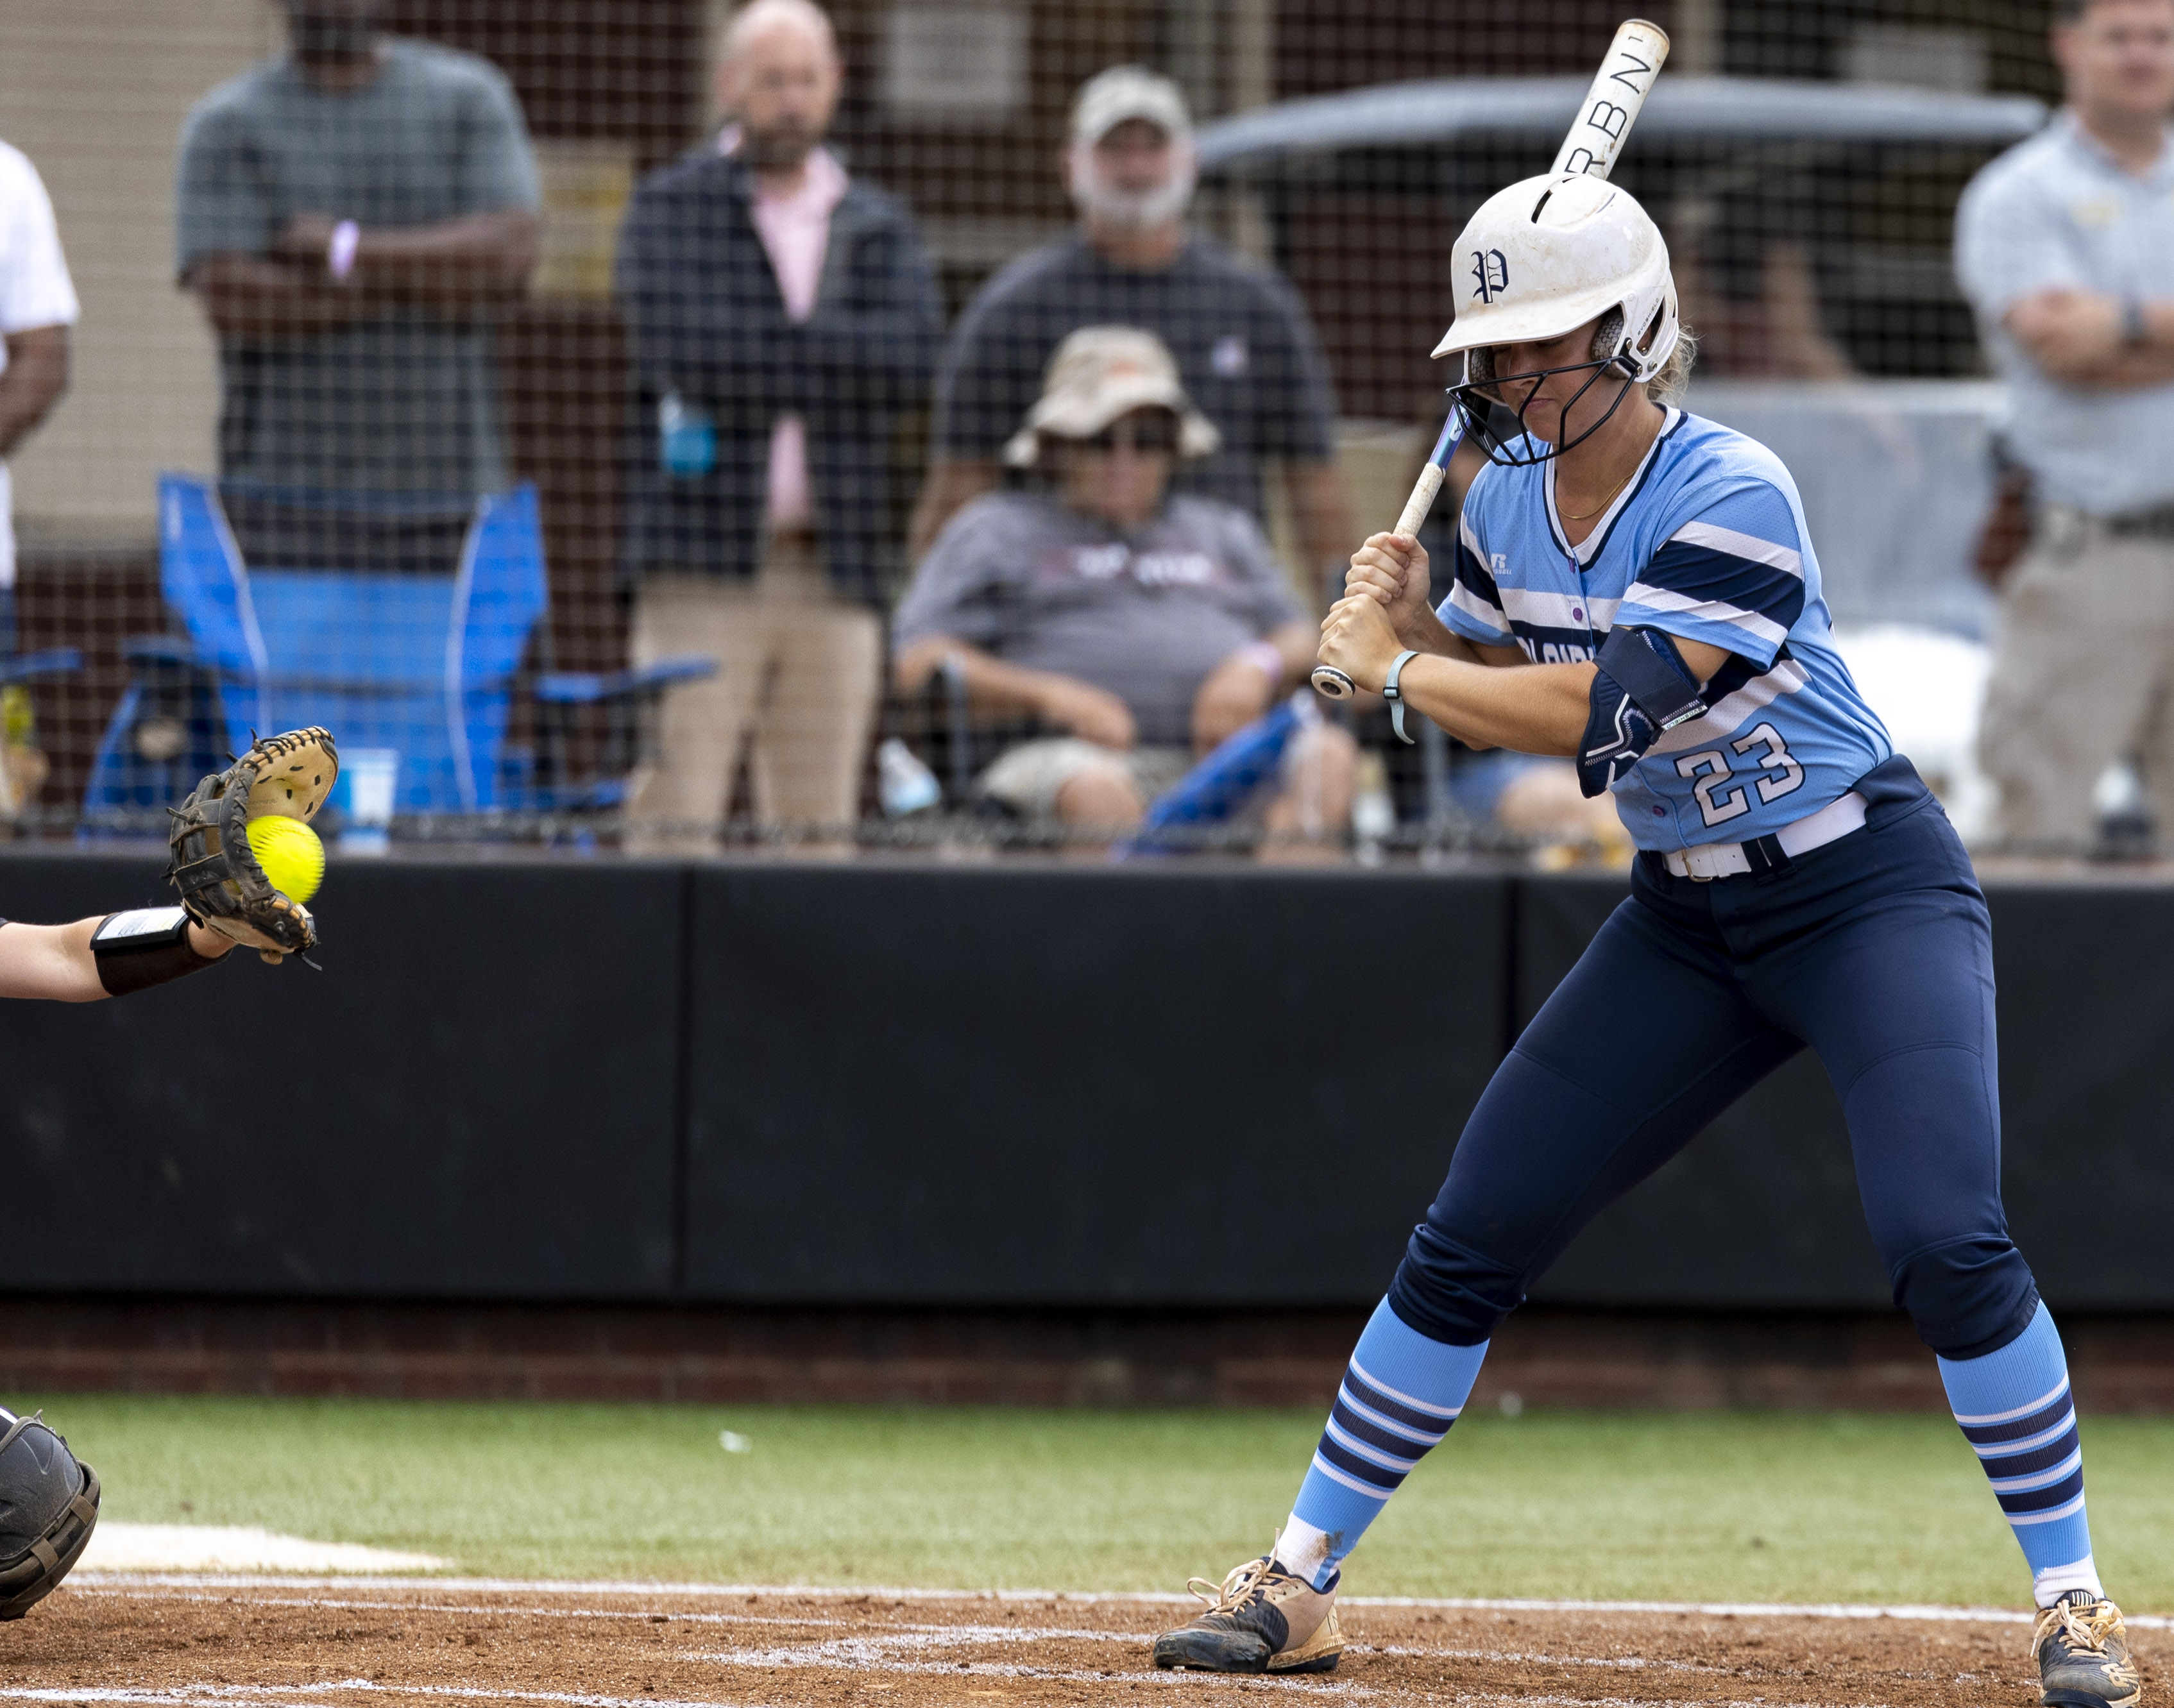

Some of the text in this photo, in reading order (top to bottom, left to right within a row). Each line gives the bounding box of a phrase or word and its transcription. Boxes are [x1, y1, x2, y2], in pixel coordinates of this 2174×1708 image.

[1470, 248, 1509, 304] P
[1667, 706, 1703, 729] EVOSHIELD
[1673, 721, 1806, 829] 23
